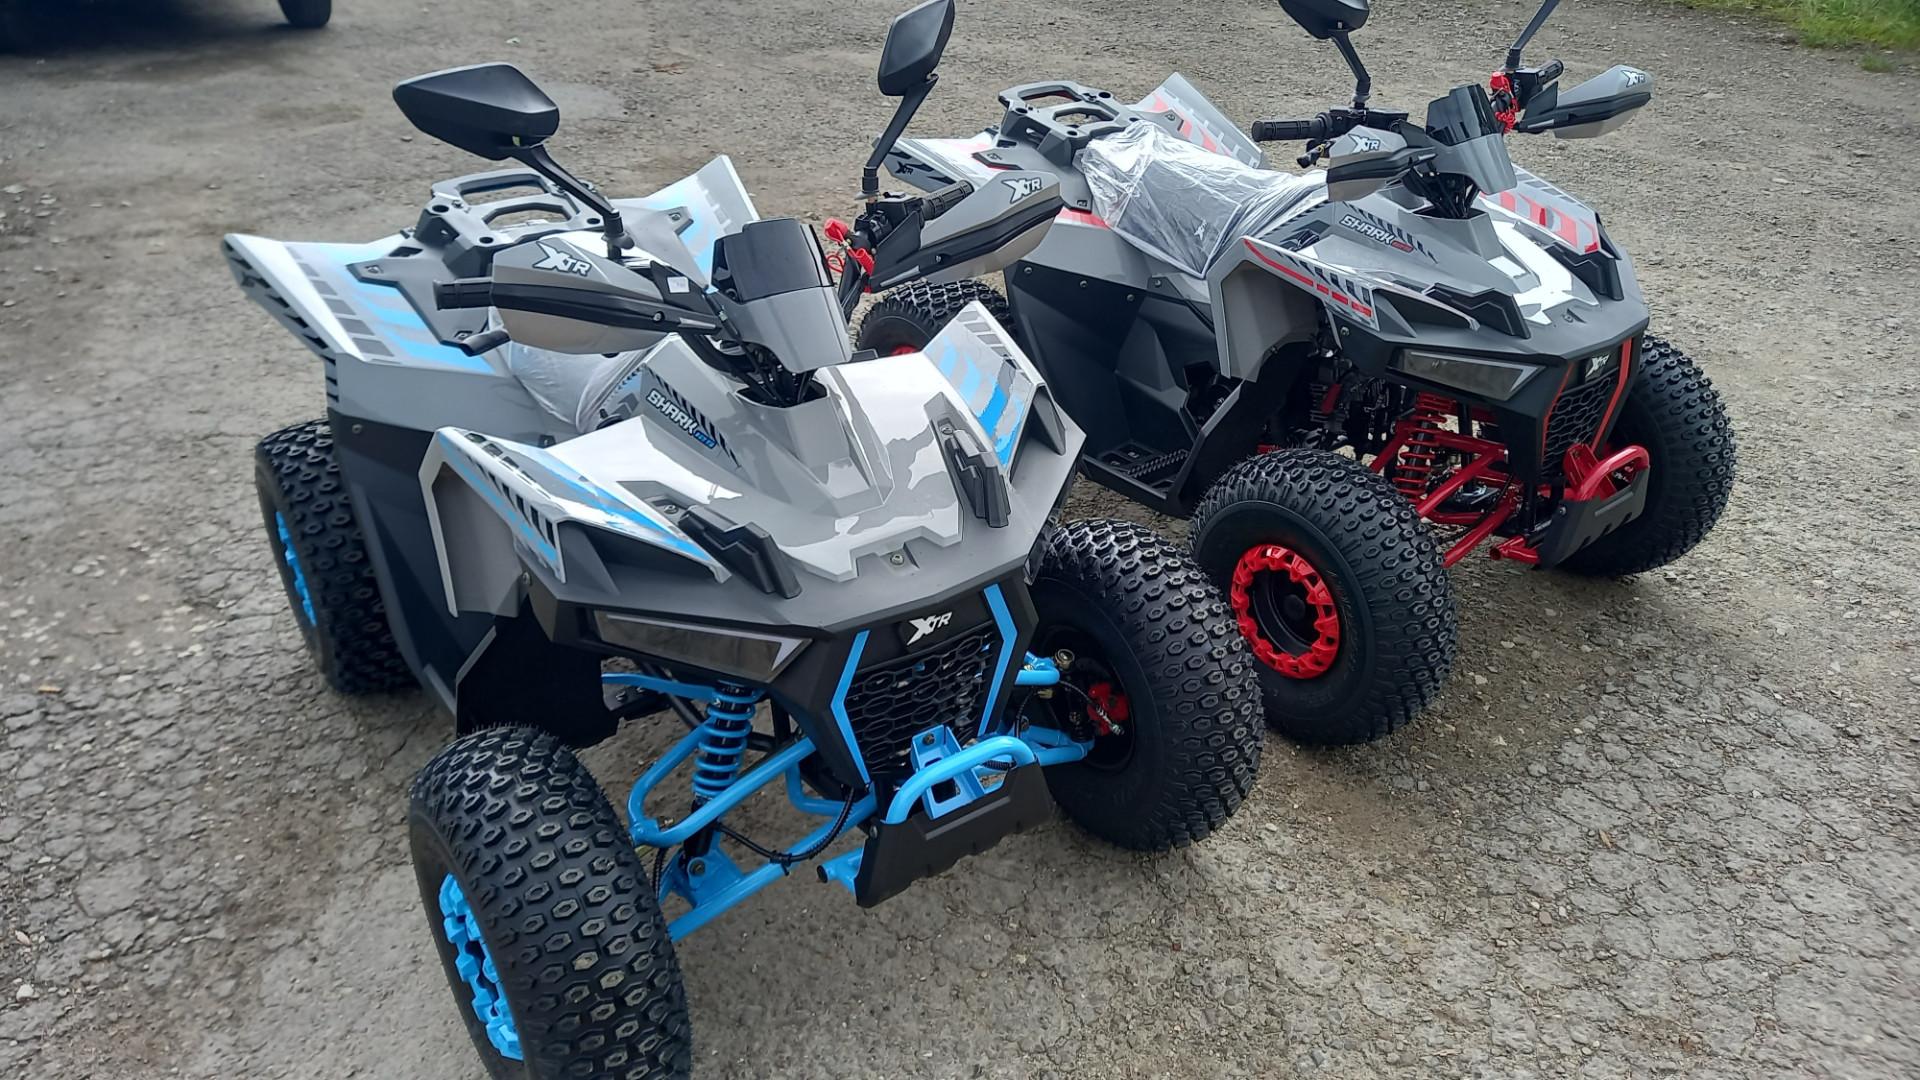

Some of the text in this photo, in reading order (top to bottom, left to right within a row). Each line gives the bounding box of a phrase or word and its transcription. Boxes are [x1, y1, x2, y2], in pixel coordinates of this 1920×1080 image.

[1348, 134, 1380, 154] XTR
[895, 161, 913, 175] XTR
[1001, 177, 1042, 204] XTR
[1340, 214, 1396, 245] SHARK
[534, 241, 591, 276] XTR
[646, 389, 699, 435] SHARK
[907, 611, 952, 646] XTR
